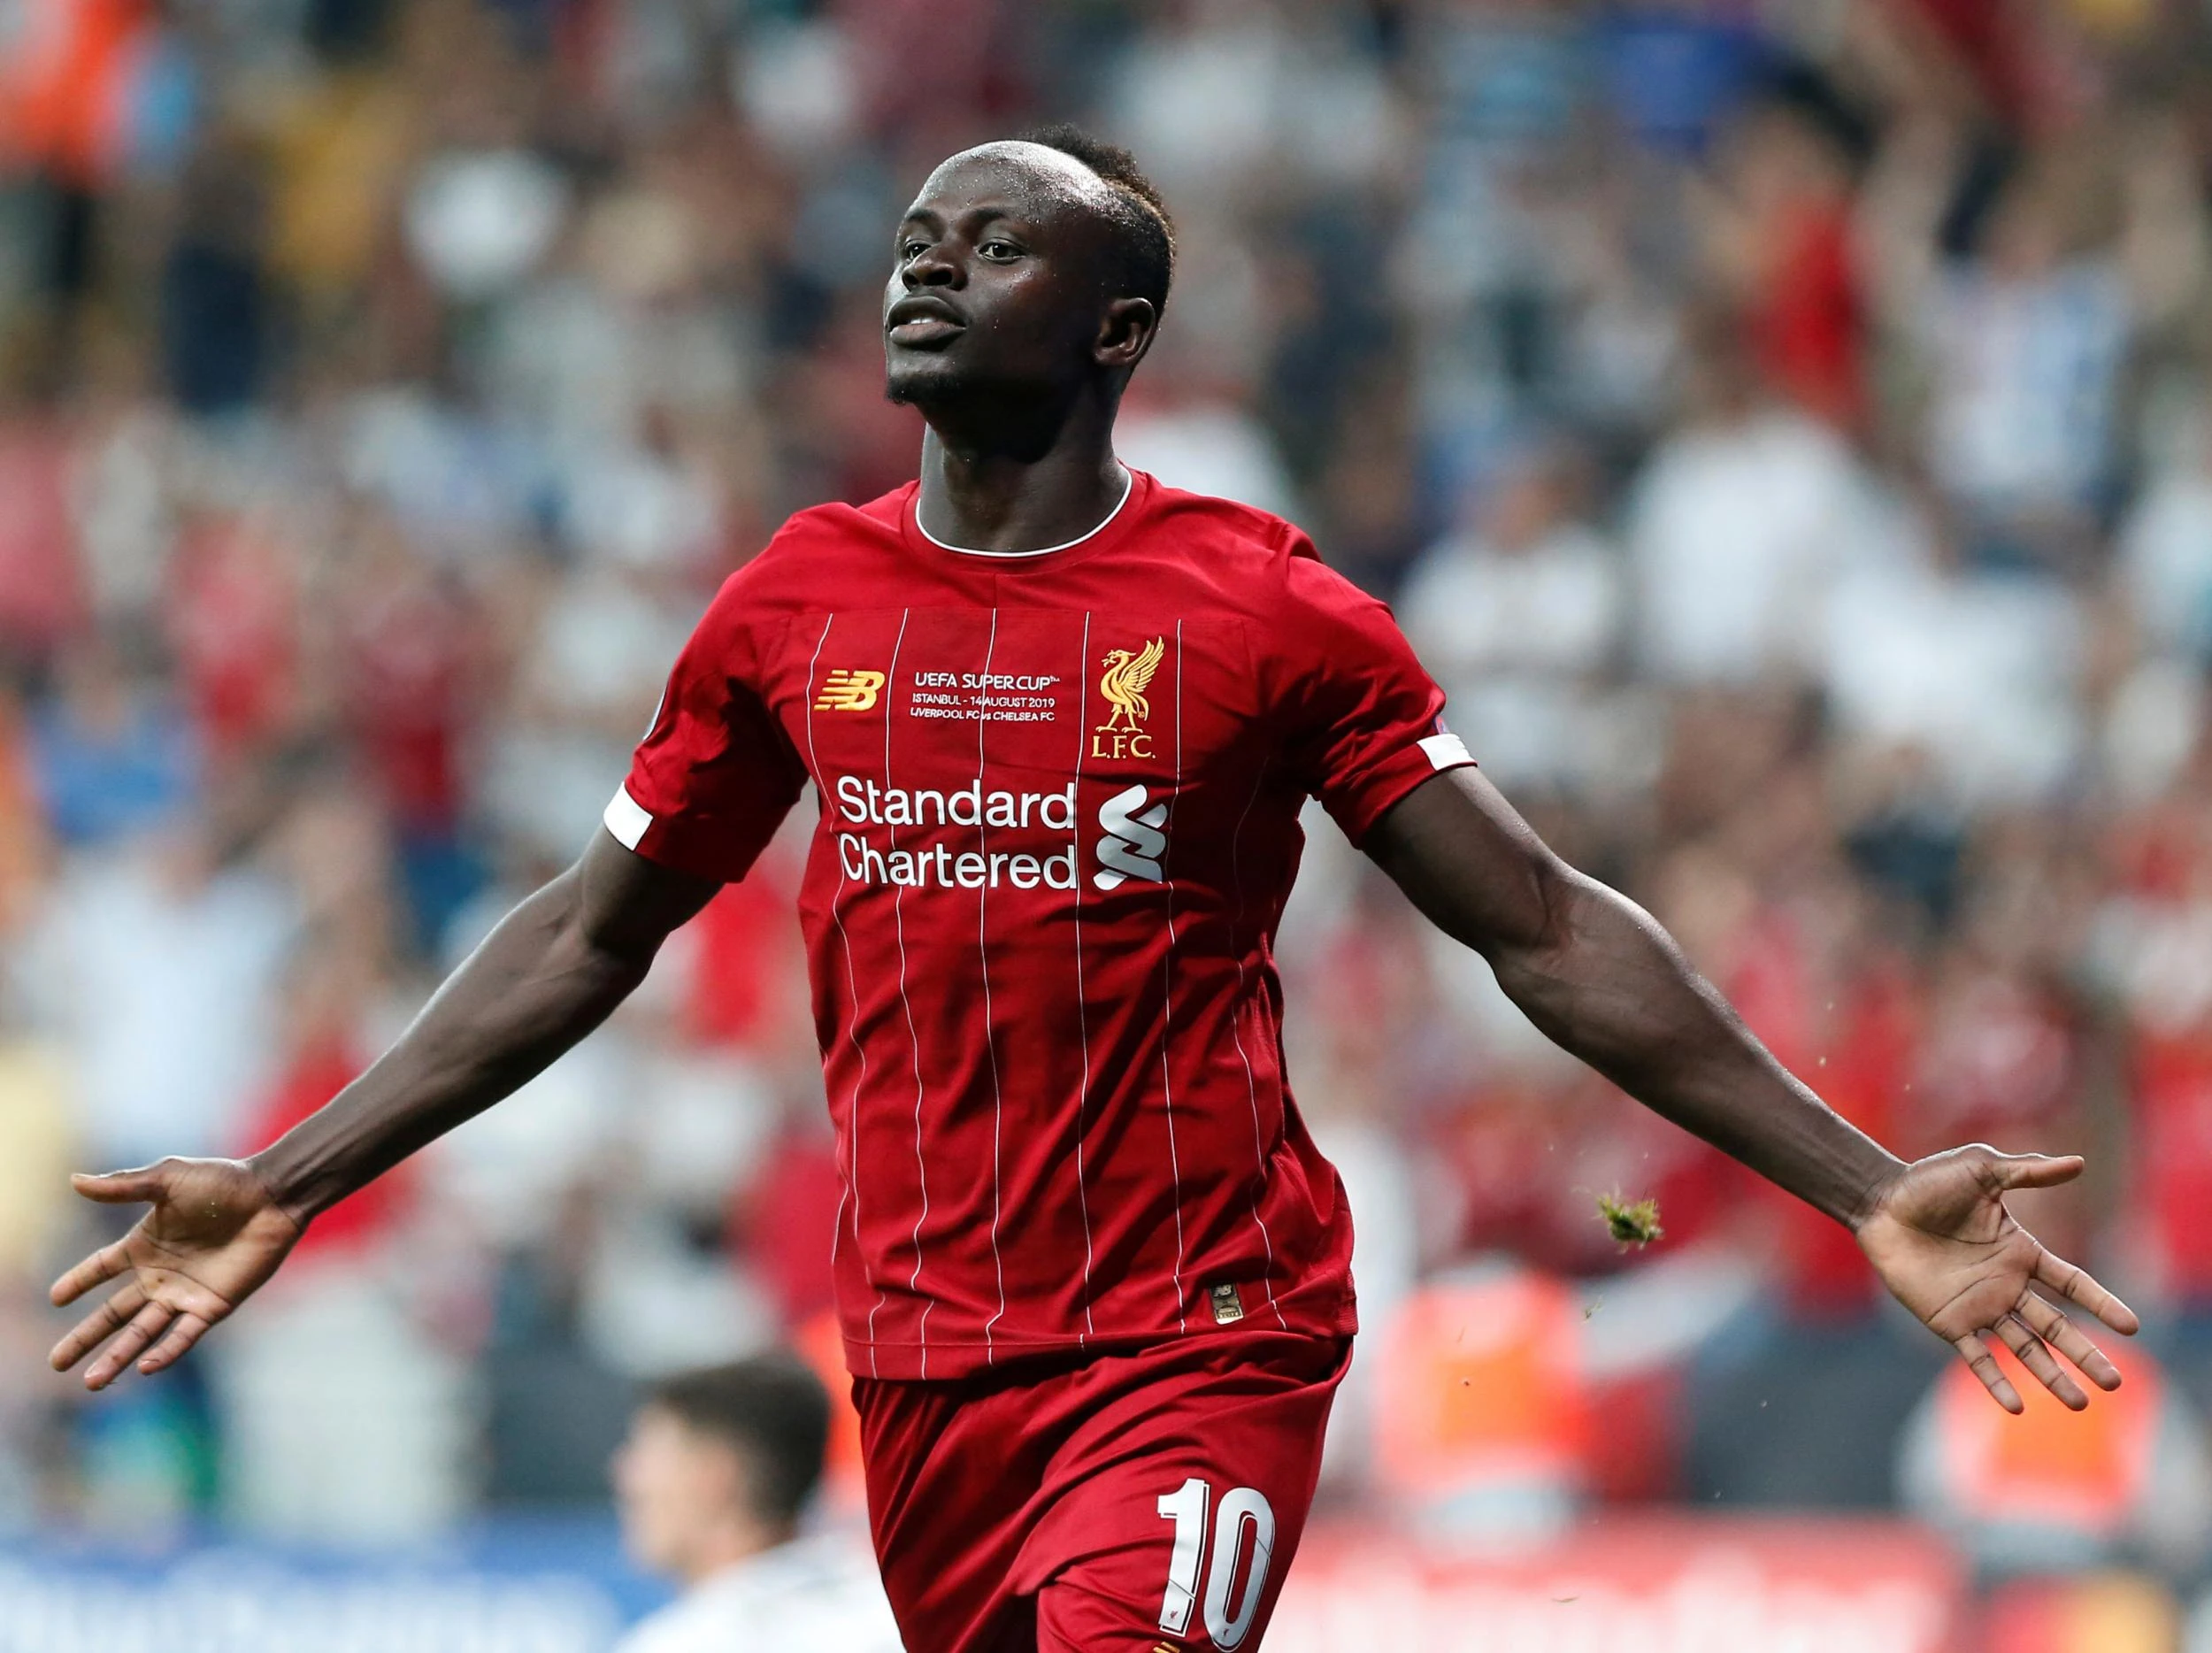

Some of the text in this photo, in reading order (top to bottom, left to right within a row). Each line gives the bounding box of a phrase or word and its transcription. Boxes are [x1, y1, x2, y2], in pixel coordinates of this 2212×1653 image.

[915, 672, 957, 688] UEFA
[962, 673, 1014, 690] SUPER
[912, 693, 961, 705] ISTANBUL
[970, 696, 982, 706] 14
[983, 696, 1027, 708] AUGUST
[1029, 697, 1055, 708] 2019
[910, 707, 964, 719] LIVERPOOL
[966, 710, 980, 720] FC
[993, 711, 1038, 721] CHELSEA
[1040, 711, 1055, 721] FC
[1091, 734, 1156, 759] L.F.C.
[836, 775, 1076, 830] Standard
[839, 833, 1078, 890] Chartered
[1157, 1477, 1276, 1653] 10
